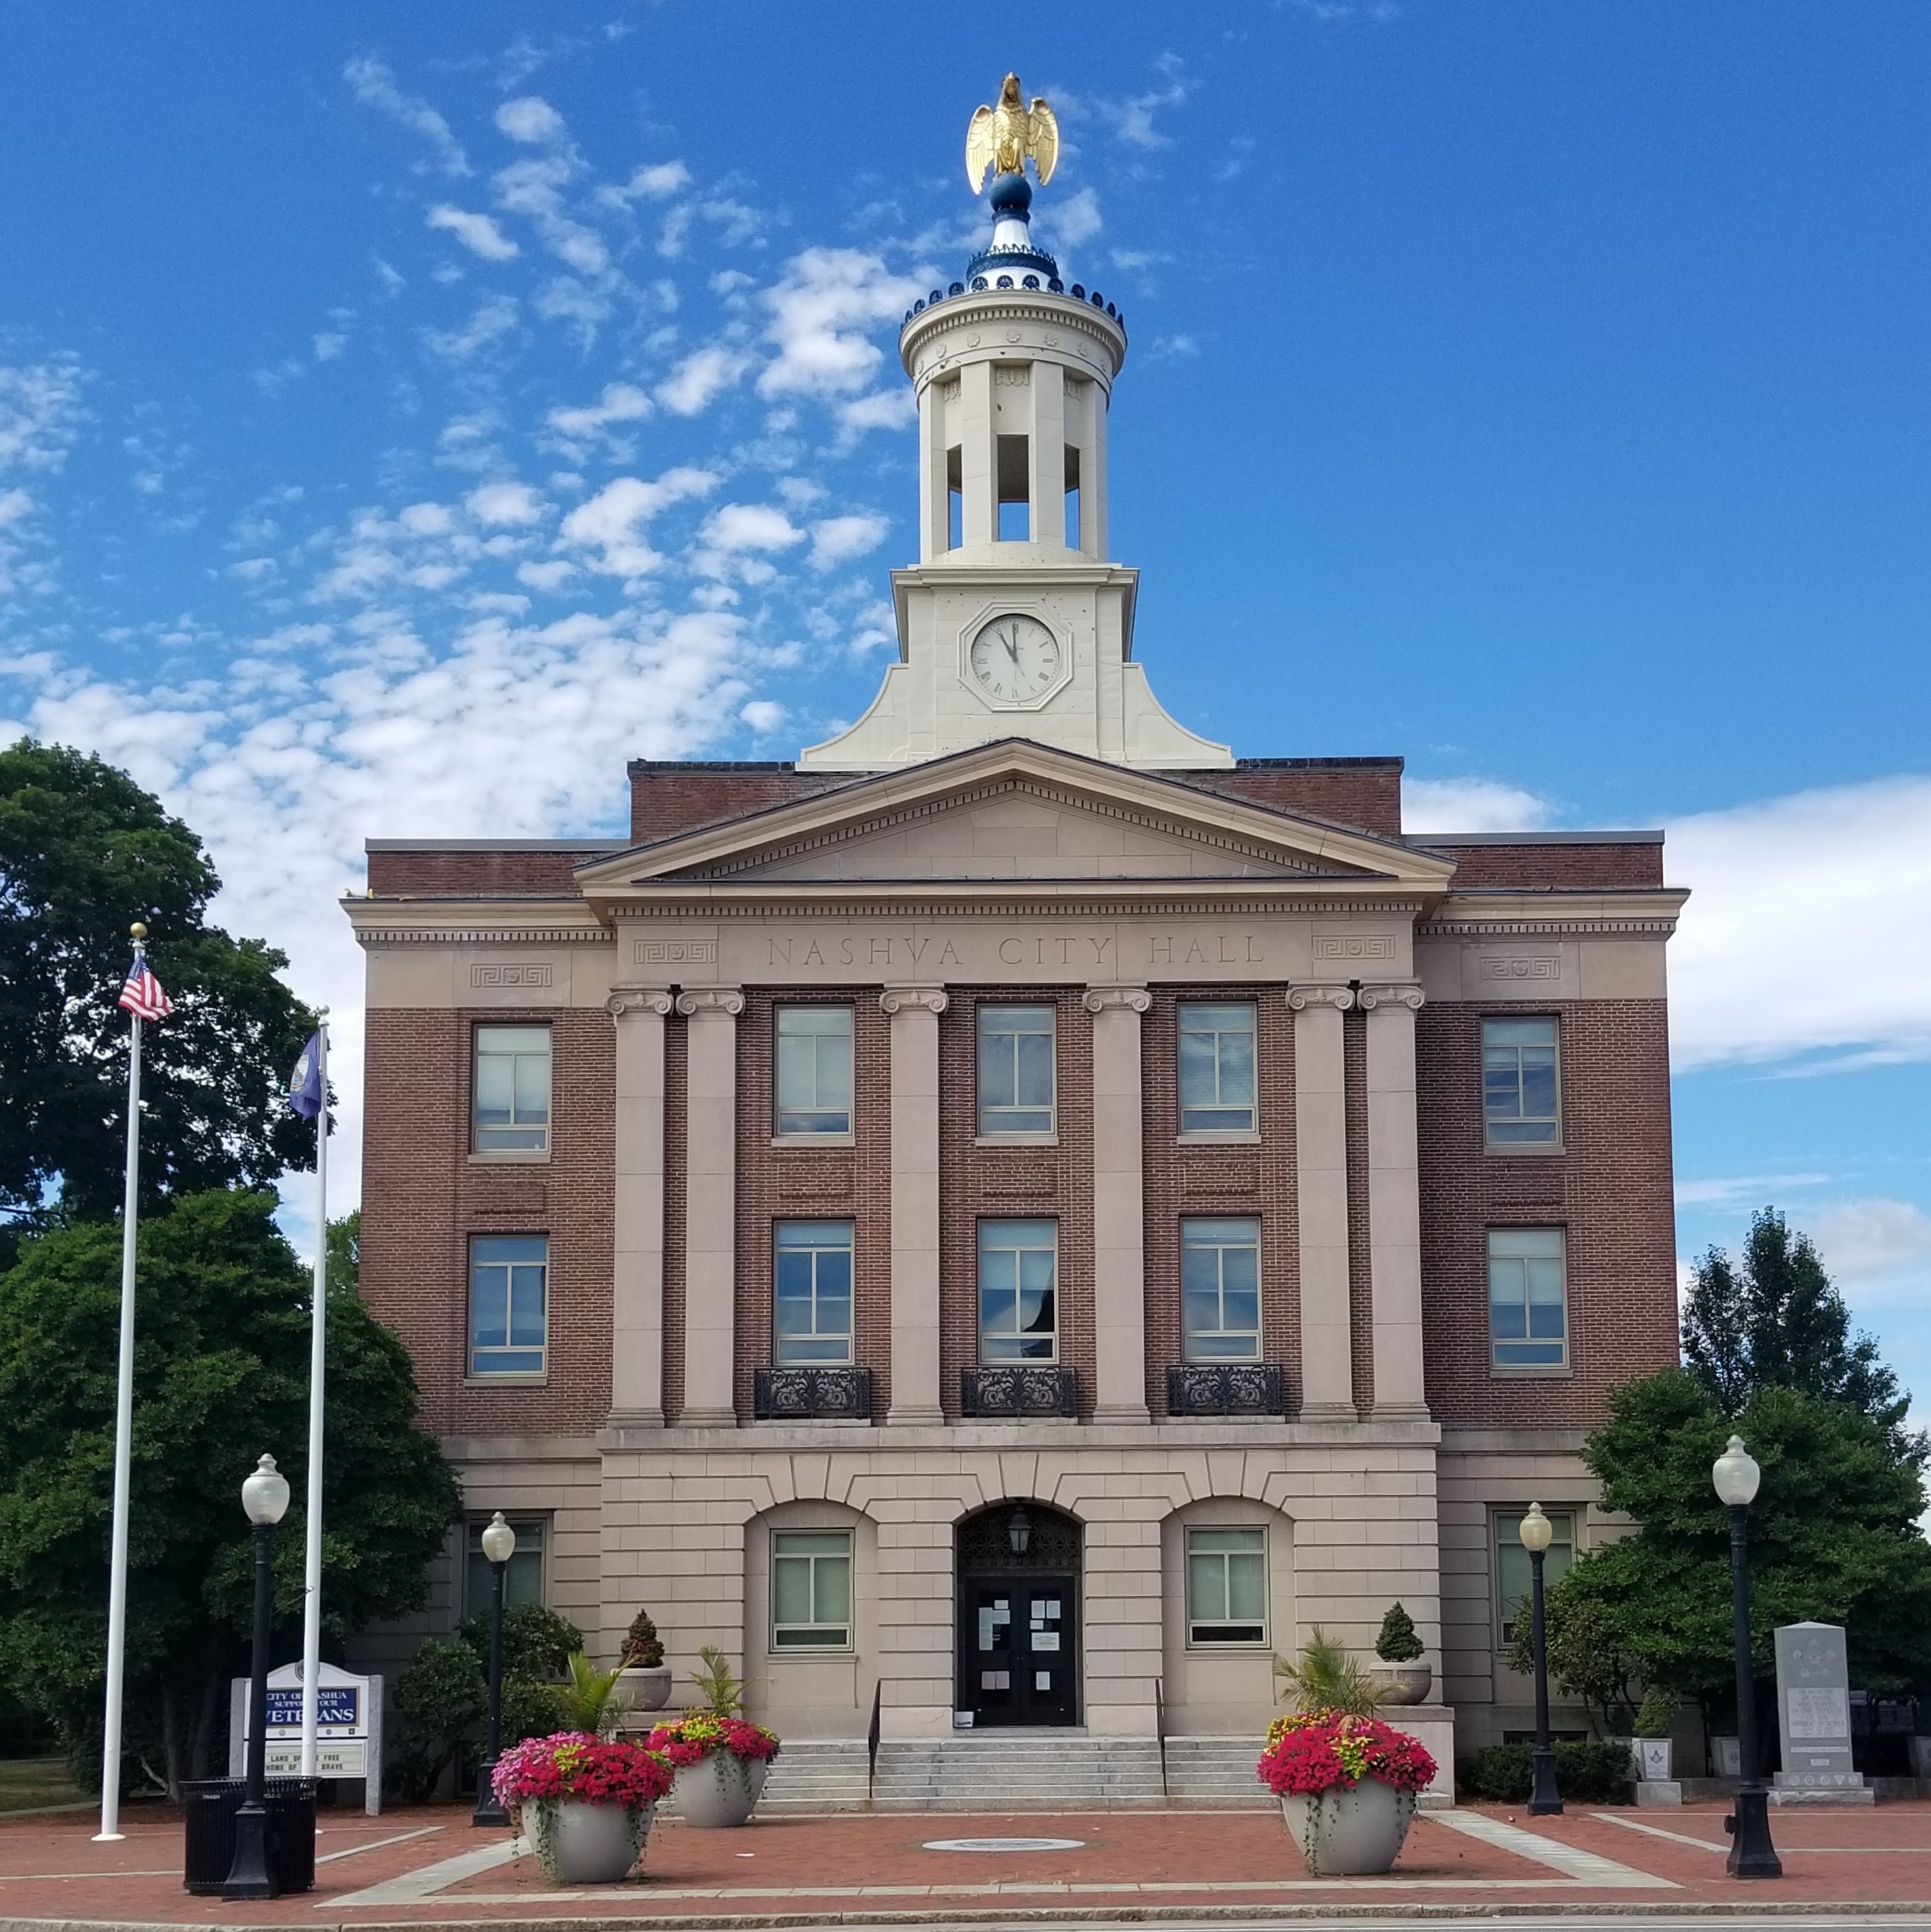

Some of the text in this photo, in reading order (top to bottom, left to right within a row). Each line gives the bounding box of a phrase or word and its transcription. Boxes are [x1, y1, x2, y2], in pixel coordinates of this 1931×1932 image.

[998, 936, 1115, 966] CITY
[1149, 935, 1265, 965] HALL
[317, 1691, 347, 1700] ASHUA
[319, 1699, 338, 1707] OUR
